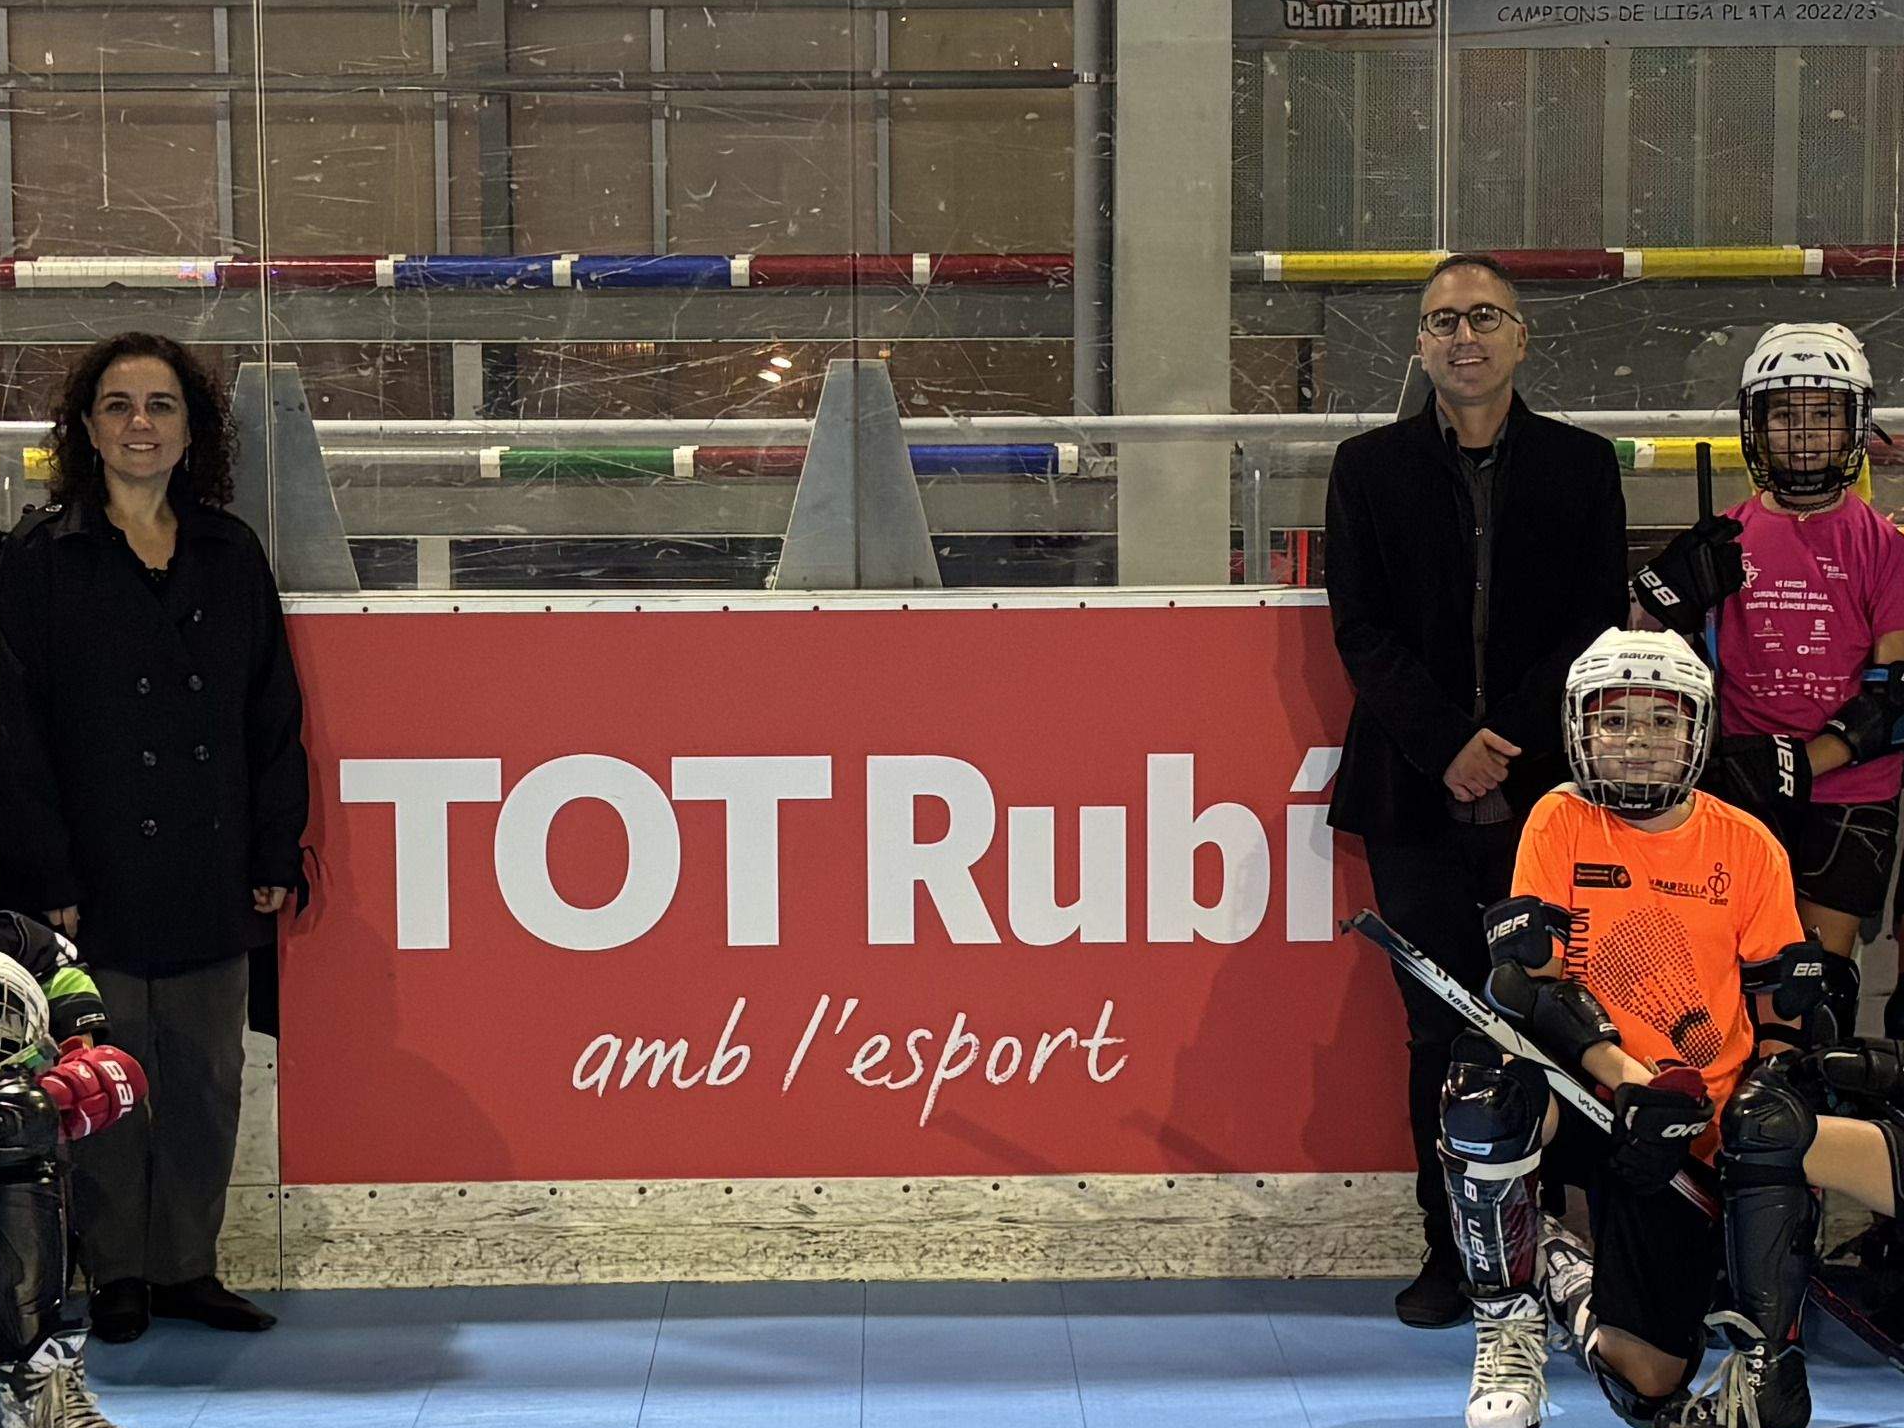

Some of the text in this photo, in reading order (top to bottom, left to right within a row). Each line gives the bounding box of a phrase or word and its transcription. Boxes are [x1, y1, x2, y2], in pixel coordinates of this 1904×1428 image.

[1497, 3, 1611, 24] CAMPIONS
[1618, 3, 1647, 22] DE
[339, 745, 1344, 952] TOT Rubí
[571, 992, 1129, 1128] amb l'esport
